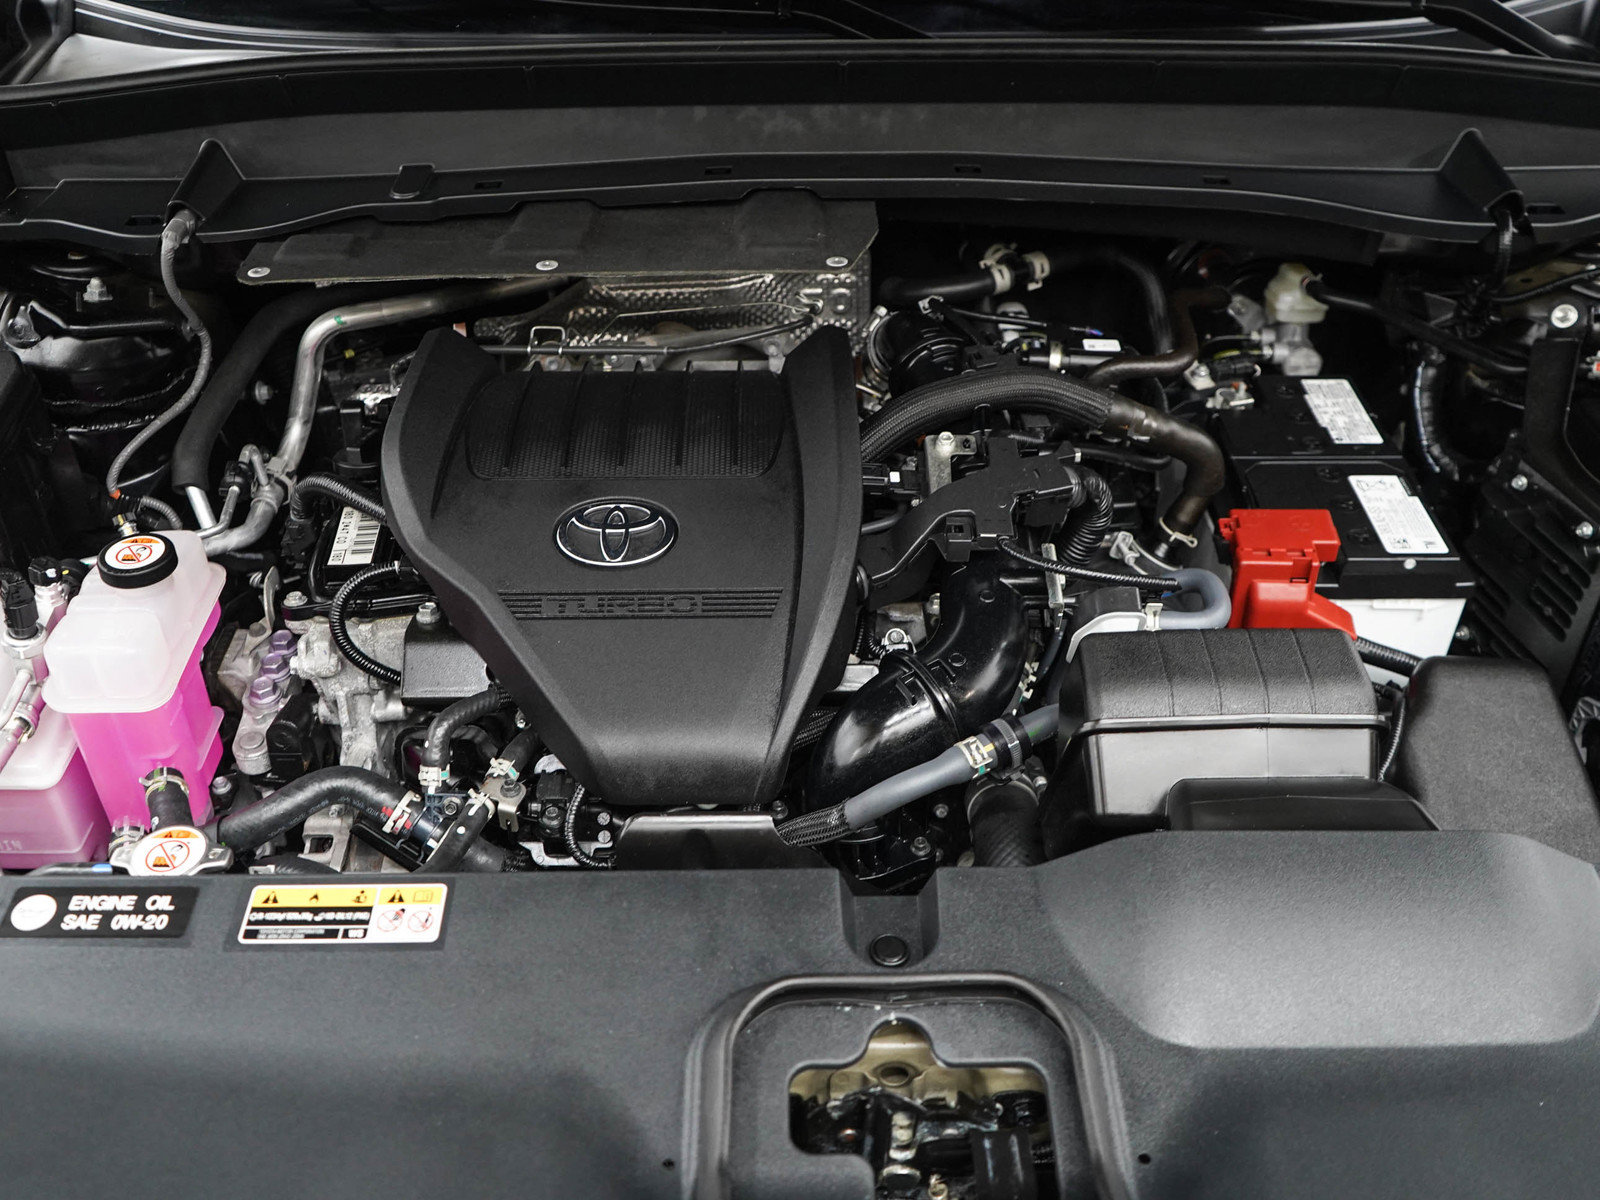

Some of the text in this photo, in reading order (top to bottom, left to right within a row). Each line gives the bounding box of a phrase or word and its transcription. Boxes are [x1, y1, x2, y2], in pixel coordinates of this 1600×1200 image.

[542, 595, 701, 614] TURBO
[68, 895, 175, 911] ENGINE OIL
[60, 914, 169, 930] SAE 0W-20
